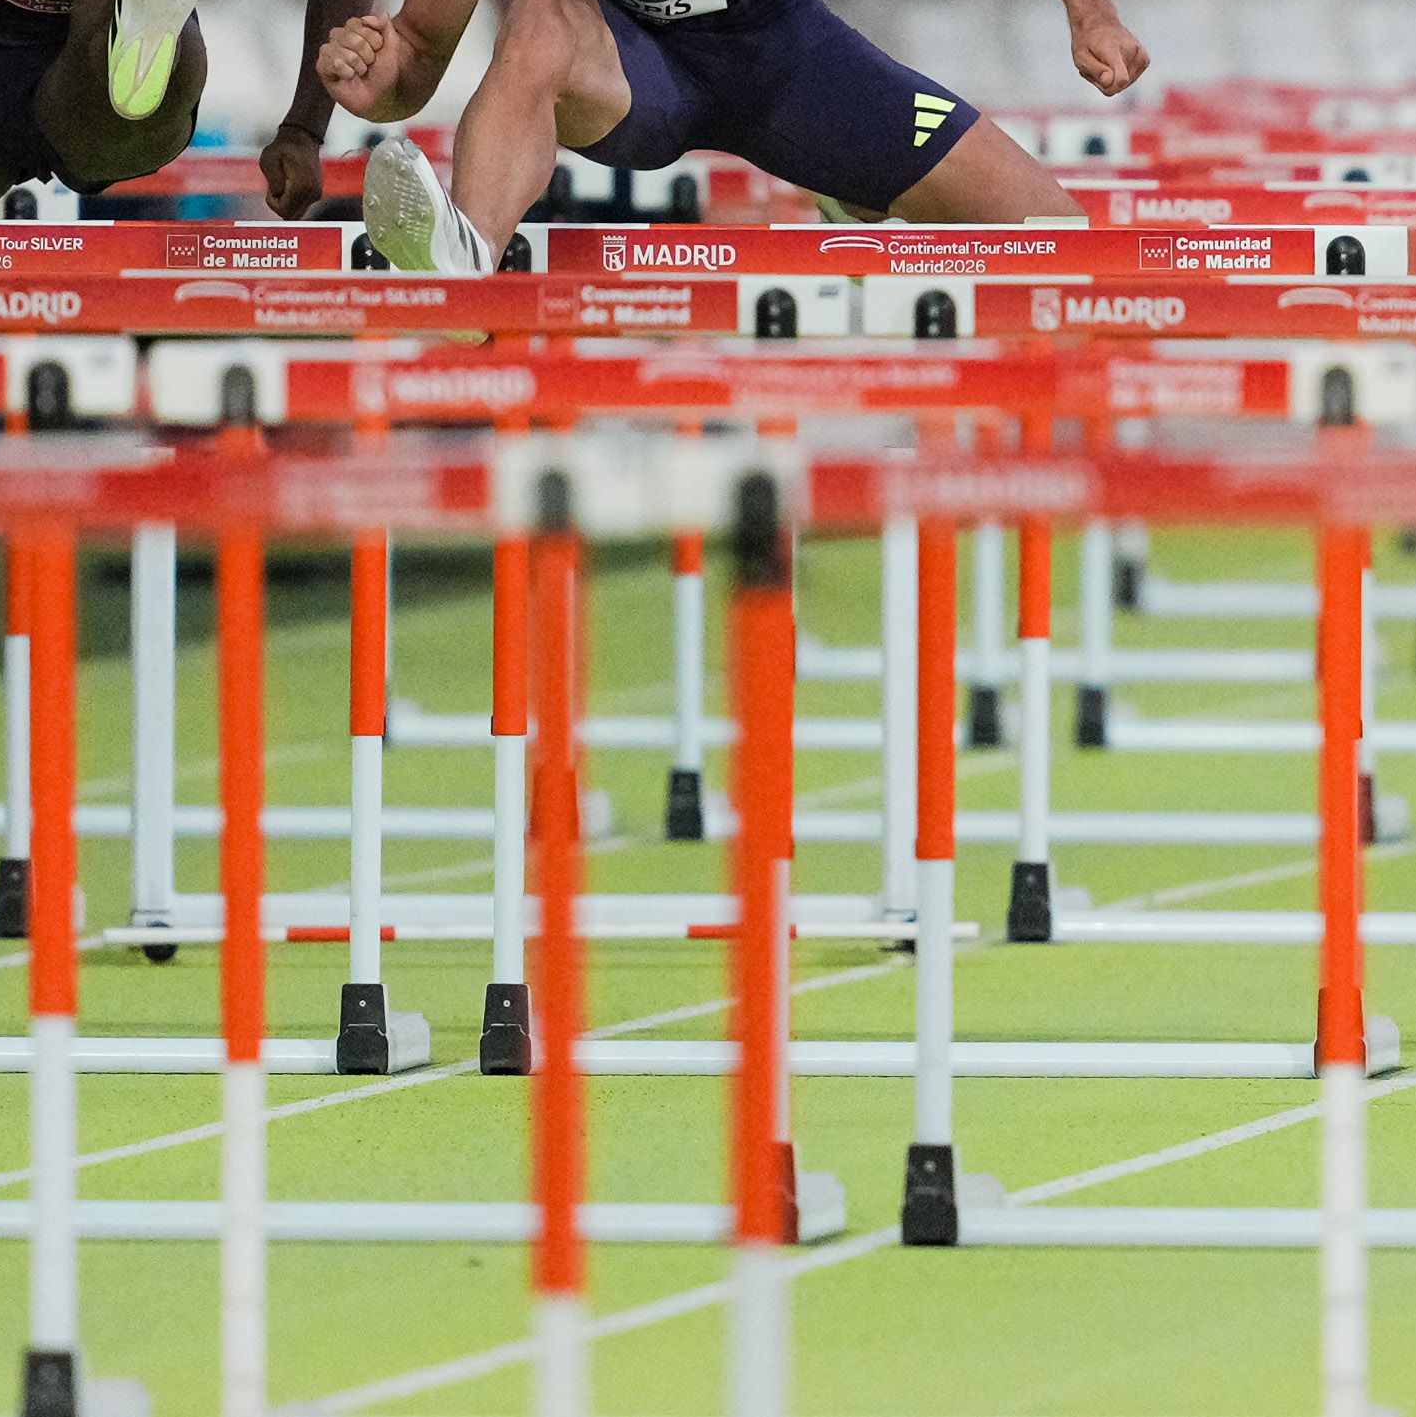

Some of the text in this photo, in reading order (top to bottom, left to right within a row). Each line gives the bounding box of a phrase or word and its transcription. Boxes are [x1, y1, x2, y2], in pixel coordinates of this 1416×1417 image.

[30, 237, 84, 250] SILVER
[202, 235, 298, 250] Comunidad
[887, 240, 1057, 255] Continental Tour SILVER
[1176, 237, 1272, 252] Comunidad
[202, 252, 298, 267] de Madrid
[632, 243, 735, 269] MADRID
[1176, 255, 1270, 269] de Madrid
[889, 259, 986, 274] Madrid2026
[1066, 297, 1185, 330] MADRID
